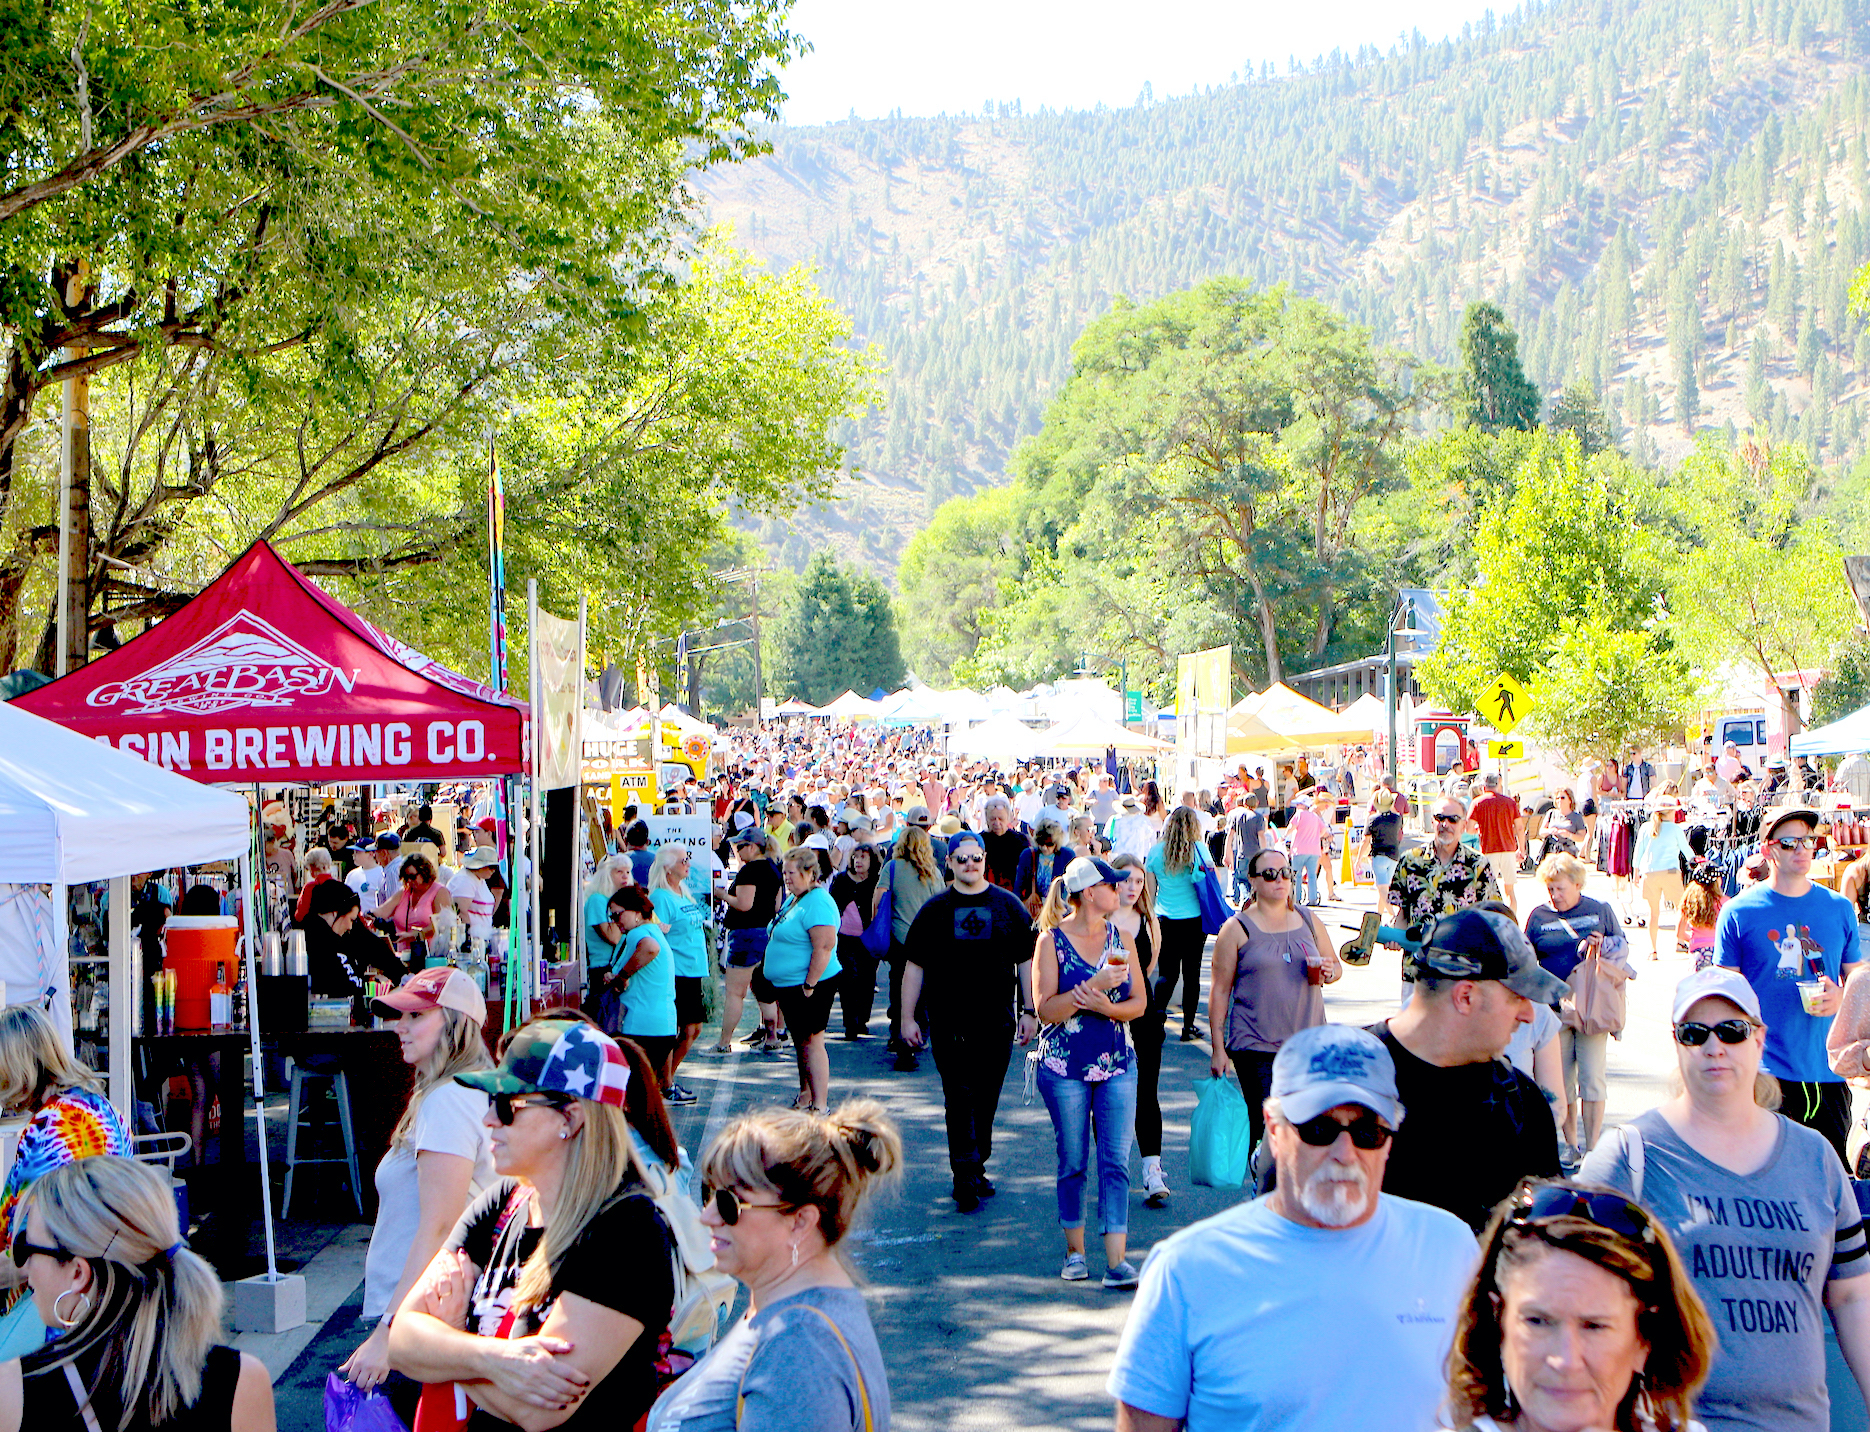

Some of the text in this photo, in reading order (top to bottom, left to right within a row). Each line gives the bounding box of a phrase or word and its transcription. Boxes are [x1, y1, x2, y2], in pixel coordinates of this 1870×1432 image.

[205, 722, 412, 769] BREWING
[427, 720, 497, 763] CO.
[584, 740, 638, 758] HUGE
[580, 757, 648, 770] PORK
[621, 776, 648, 788] ATM
[1687, 1194, 1810, 1232] I'M DONE
[1693, 1243, 1815, 1283] ADULTING
[1720, 1298, 1799, 1334] TODAY
